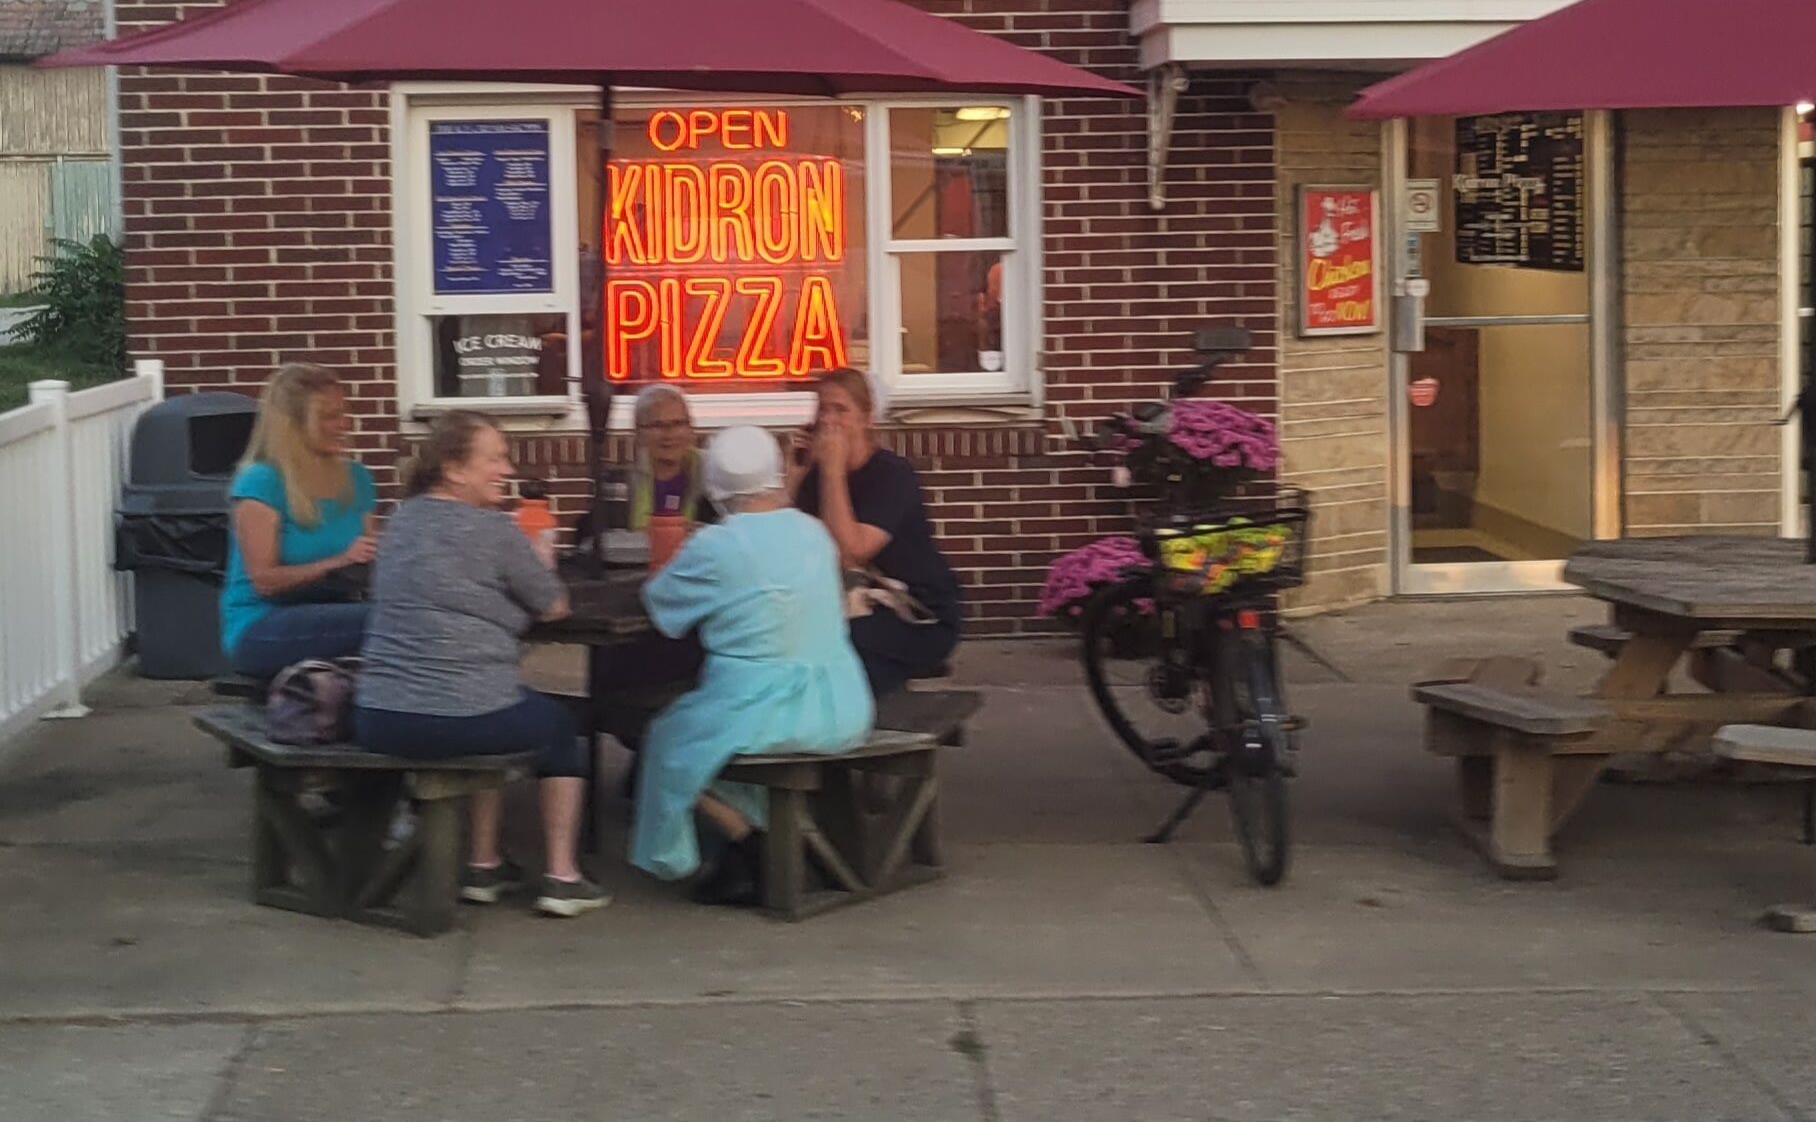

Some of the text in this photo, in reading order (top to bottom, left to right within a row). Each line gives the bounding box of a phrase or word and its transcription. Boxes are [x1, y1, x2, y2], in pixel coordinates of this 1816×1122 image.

[648, 109, 790, 151] OPEN
[605, 160, 846, 265] KIDRON
[452, 333, 542, 354] ICE CREAM
[605, 275, 848, 379] PIZZA
